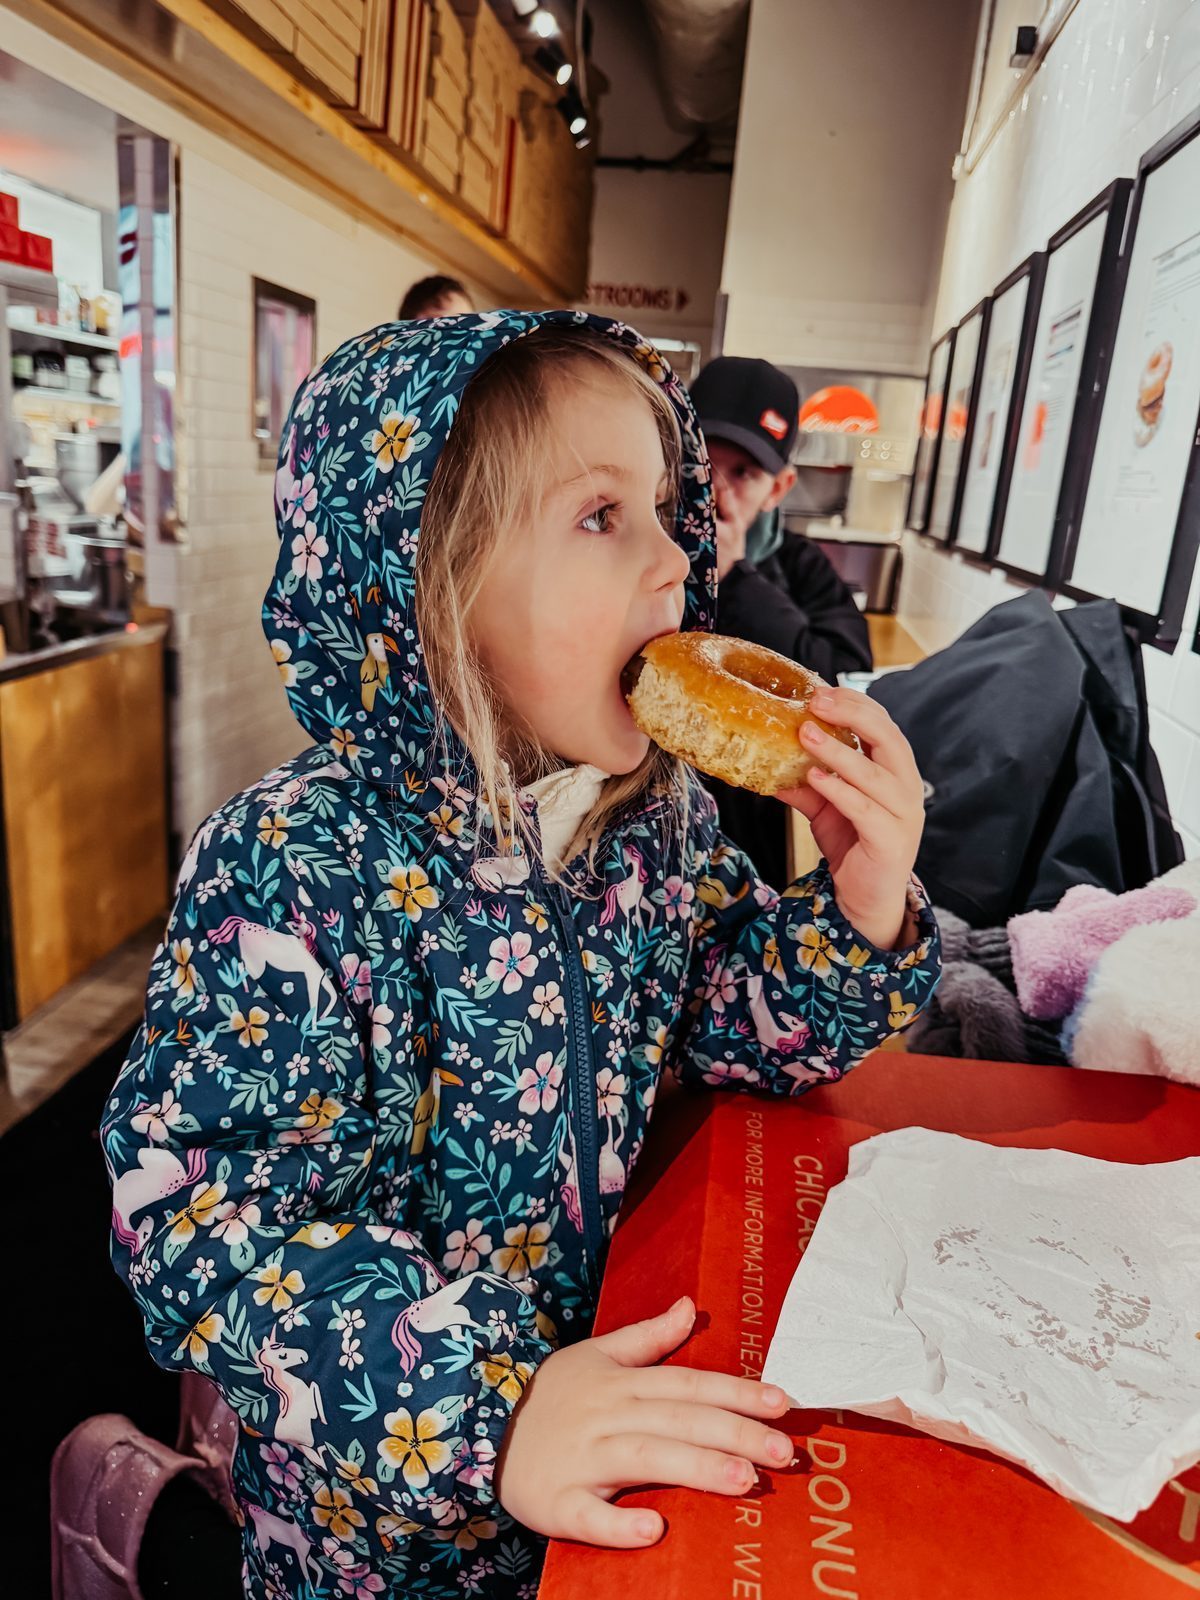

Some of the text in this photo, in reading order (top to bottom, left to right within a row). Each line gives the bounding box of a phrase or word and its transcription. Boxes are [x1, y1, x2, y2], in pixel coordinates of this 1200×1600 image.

[745, 1110, 763, 1139] FOR
[745, 1142, 764, 1187] MORE
[741, 1189, 764, 1325] INFORMATION
[806, 1437, 859, 1600] DONU
